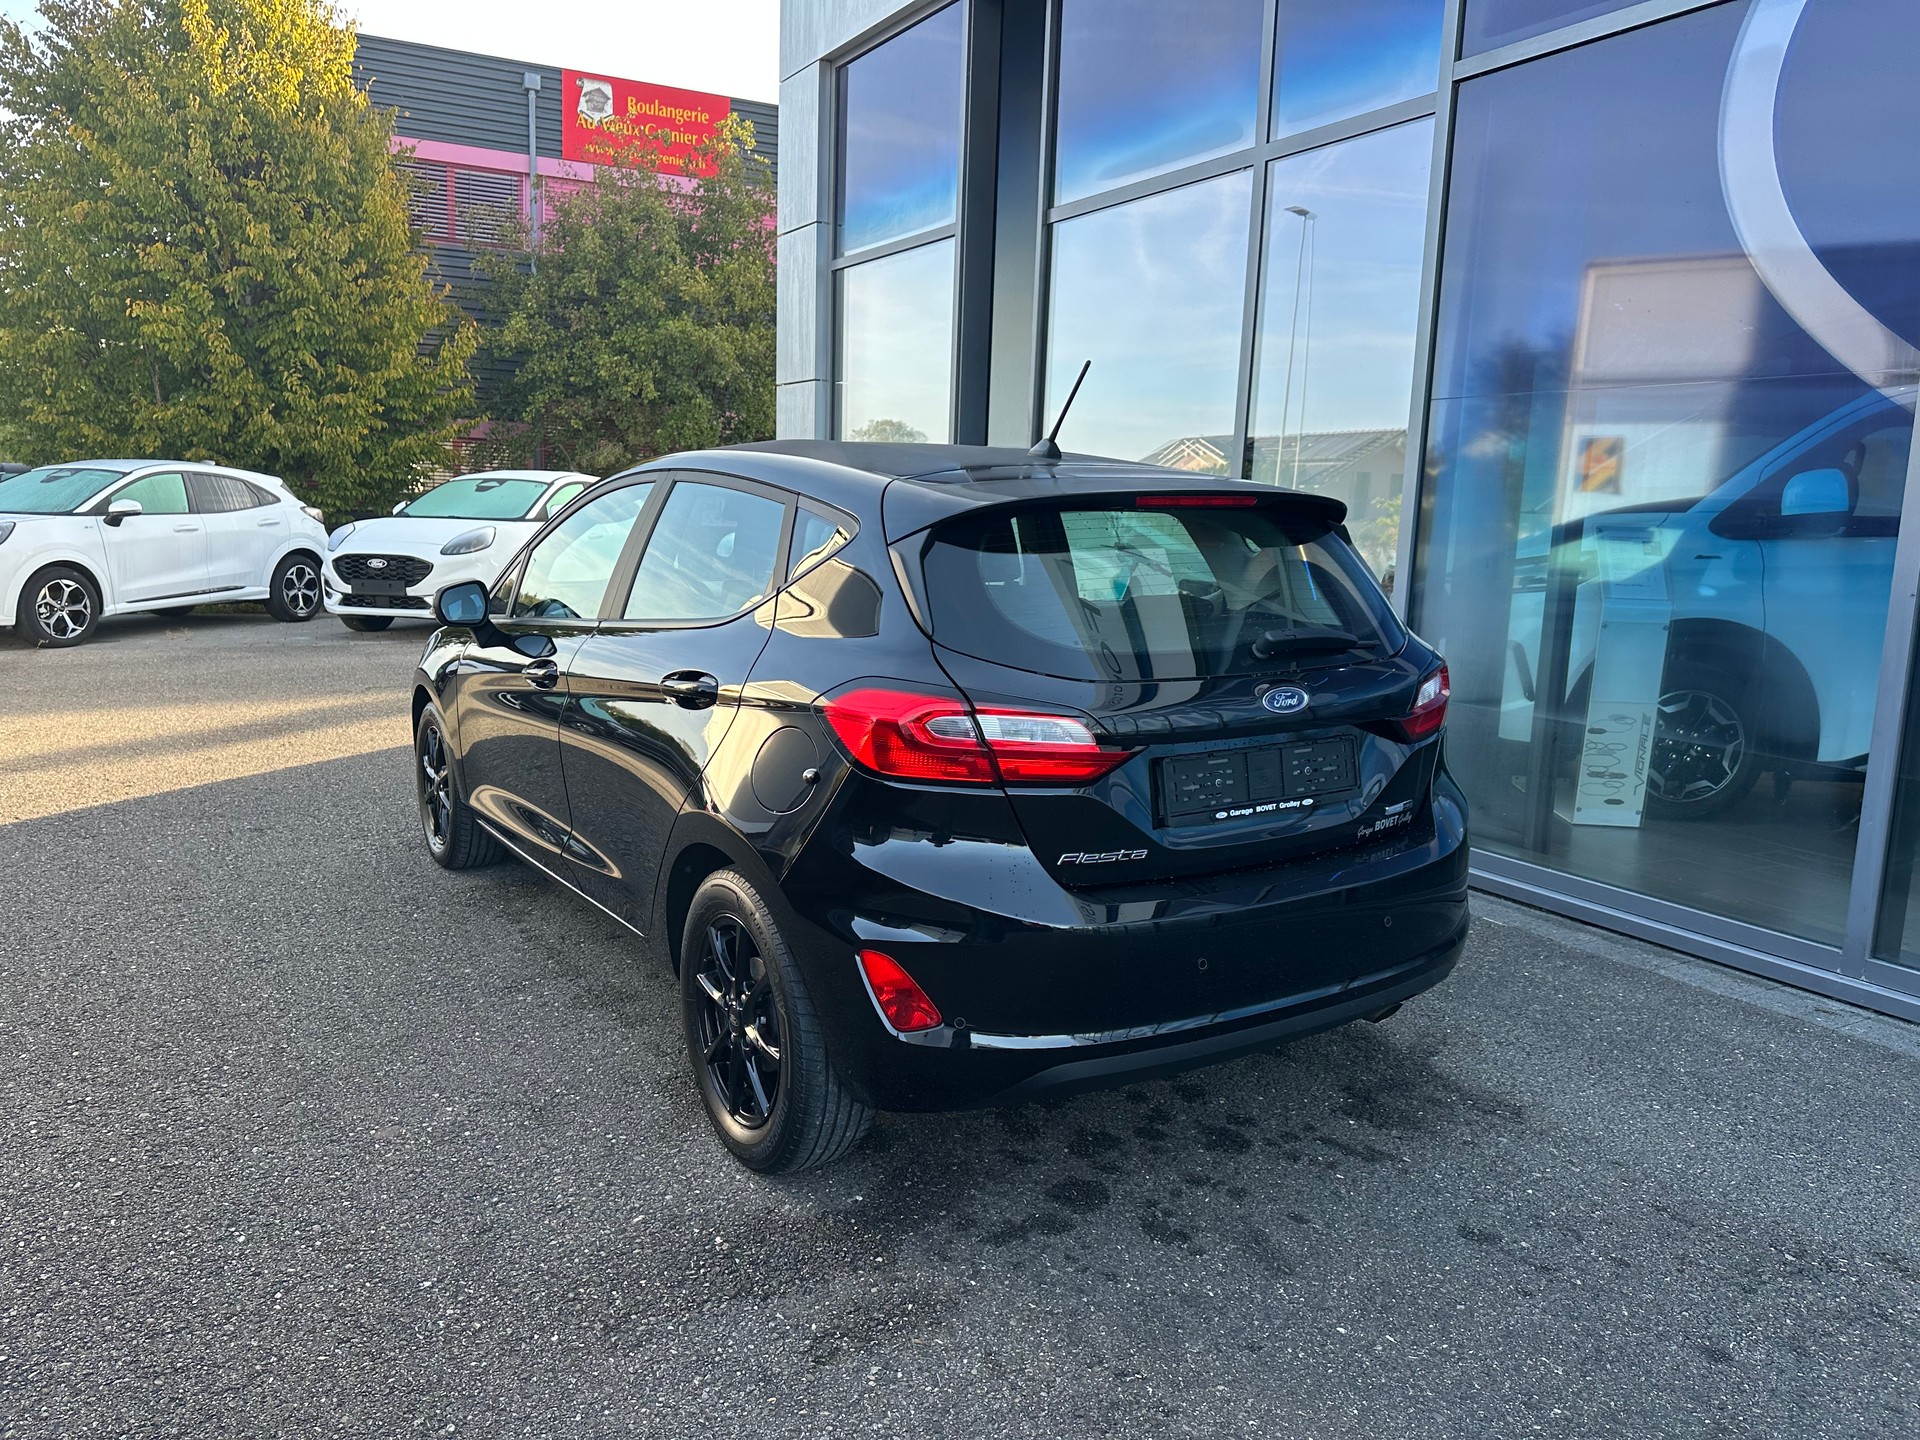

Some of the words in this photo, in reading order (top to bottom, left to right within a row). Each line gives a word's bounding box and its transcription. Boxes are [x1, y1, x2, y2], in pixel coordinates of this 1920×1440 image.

[627, 96, 710, 125] Boulangerie
[575, 112, 596, 130] Au
[645, 122, 698, 145] Grnier
[1229, 807, 1254, 817] Garage
[1256, 803, 1277, 813] BOVET
[1279, 800, 1301, 809] Grolley
[1374, 815, 1399, 832] BOVET
[1057, 849, 1149, 866] Fiesta
